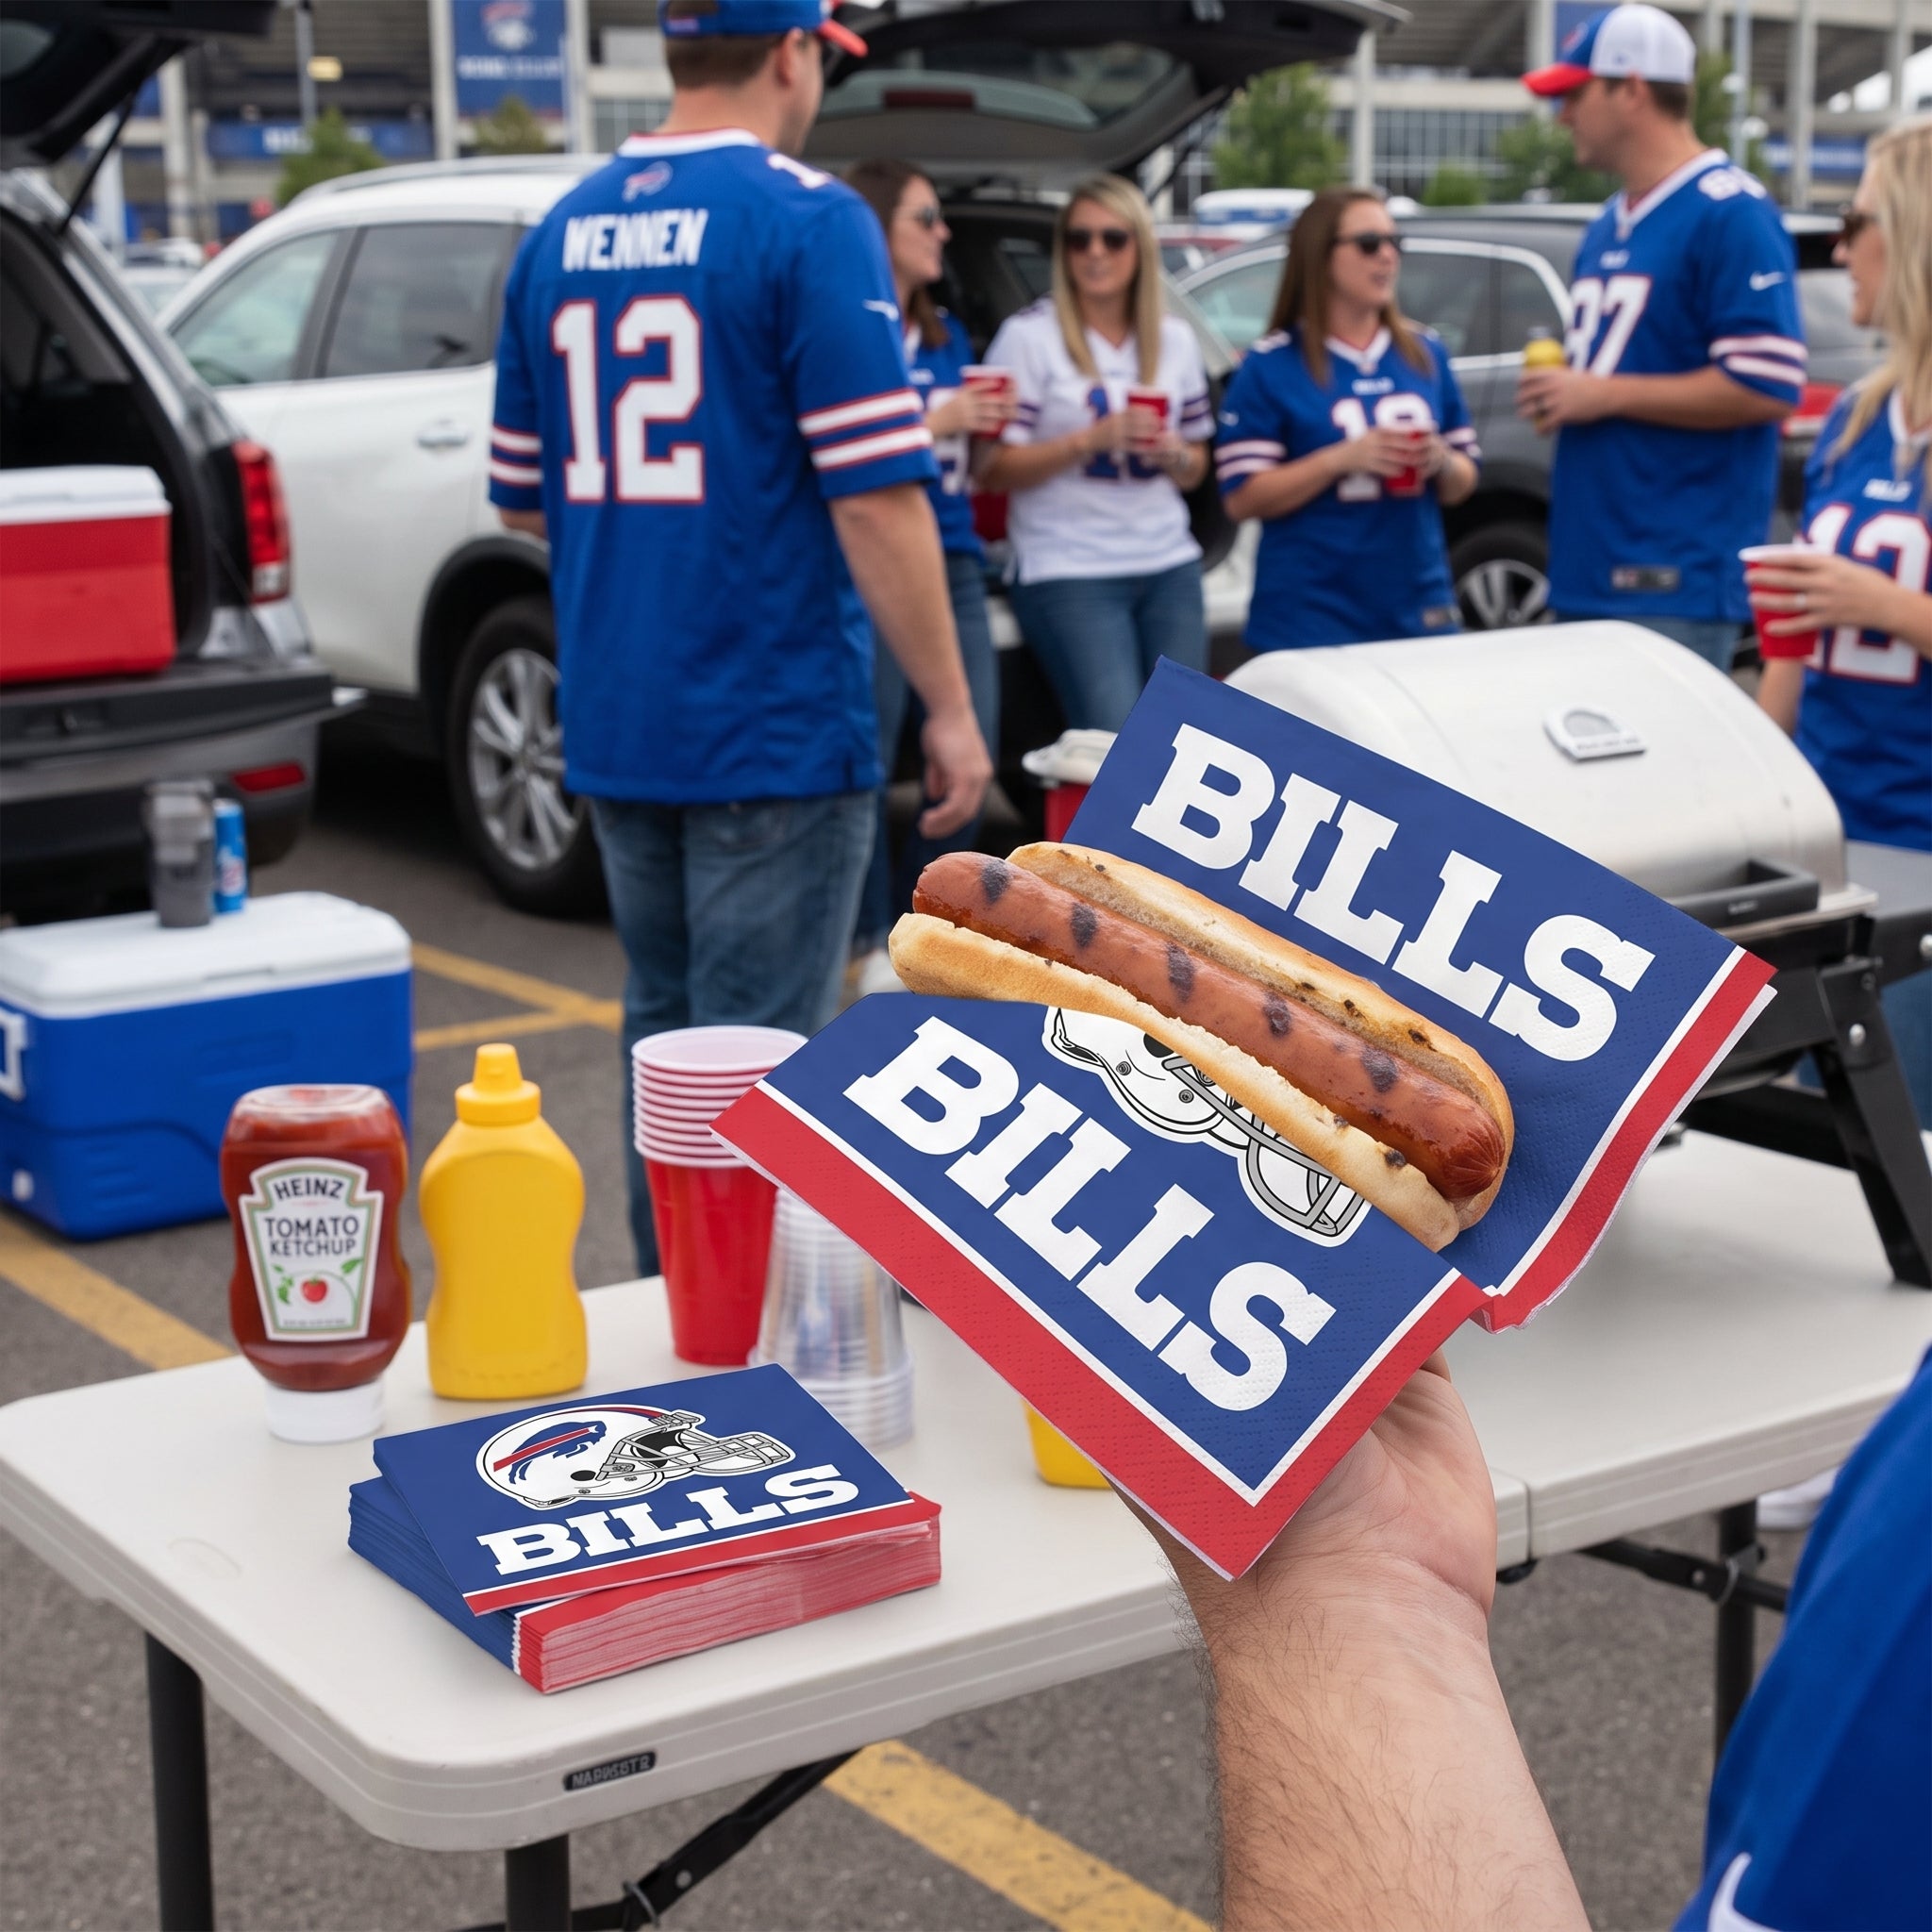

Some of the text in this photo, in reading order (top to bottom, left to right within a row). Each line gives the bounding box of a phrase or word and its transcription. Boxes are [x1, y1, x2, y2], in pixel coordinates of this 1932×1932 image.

[550, 293, 706, 505] 12
[1130, 723, 1657, 1062] BILLS
[264, 1215, 359, 1239] TOMATO
[274, 1177, 344, 1200] HEINZ
[841, 1015, 1338, 1411] BILLS
[270, 1239, 356, 1257] KETCHUP
[476, 1463, 859, 1576] BILLS
